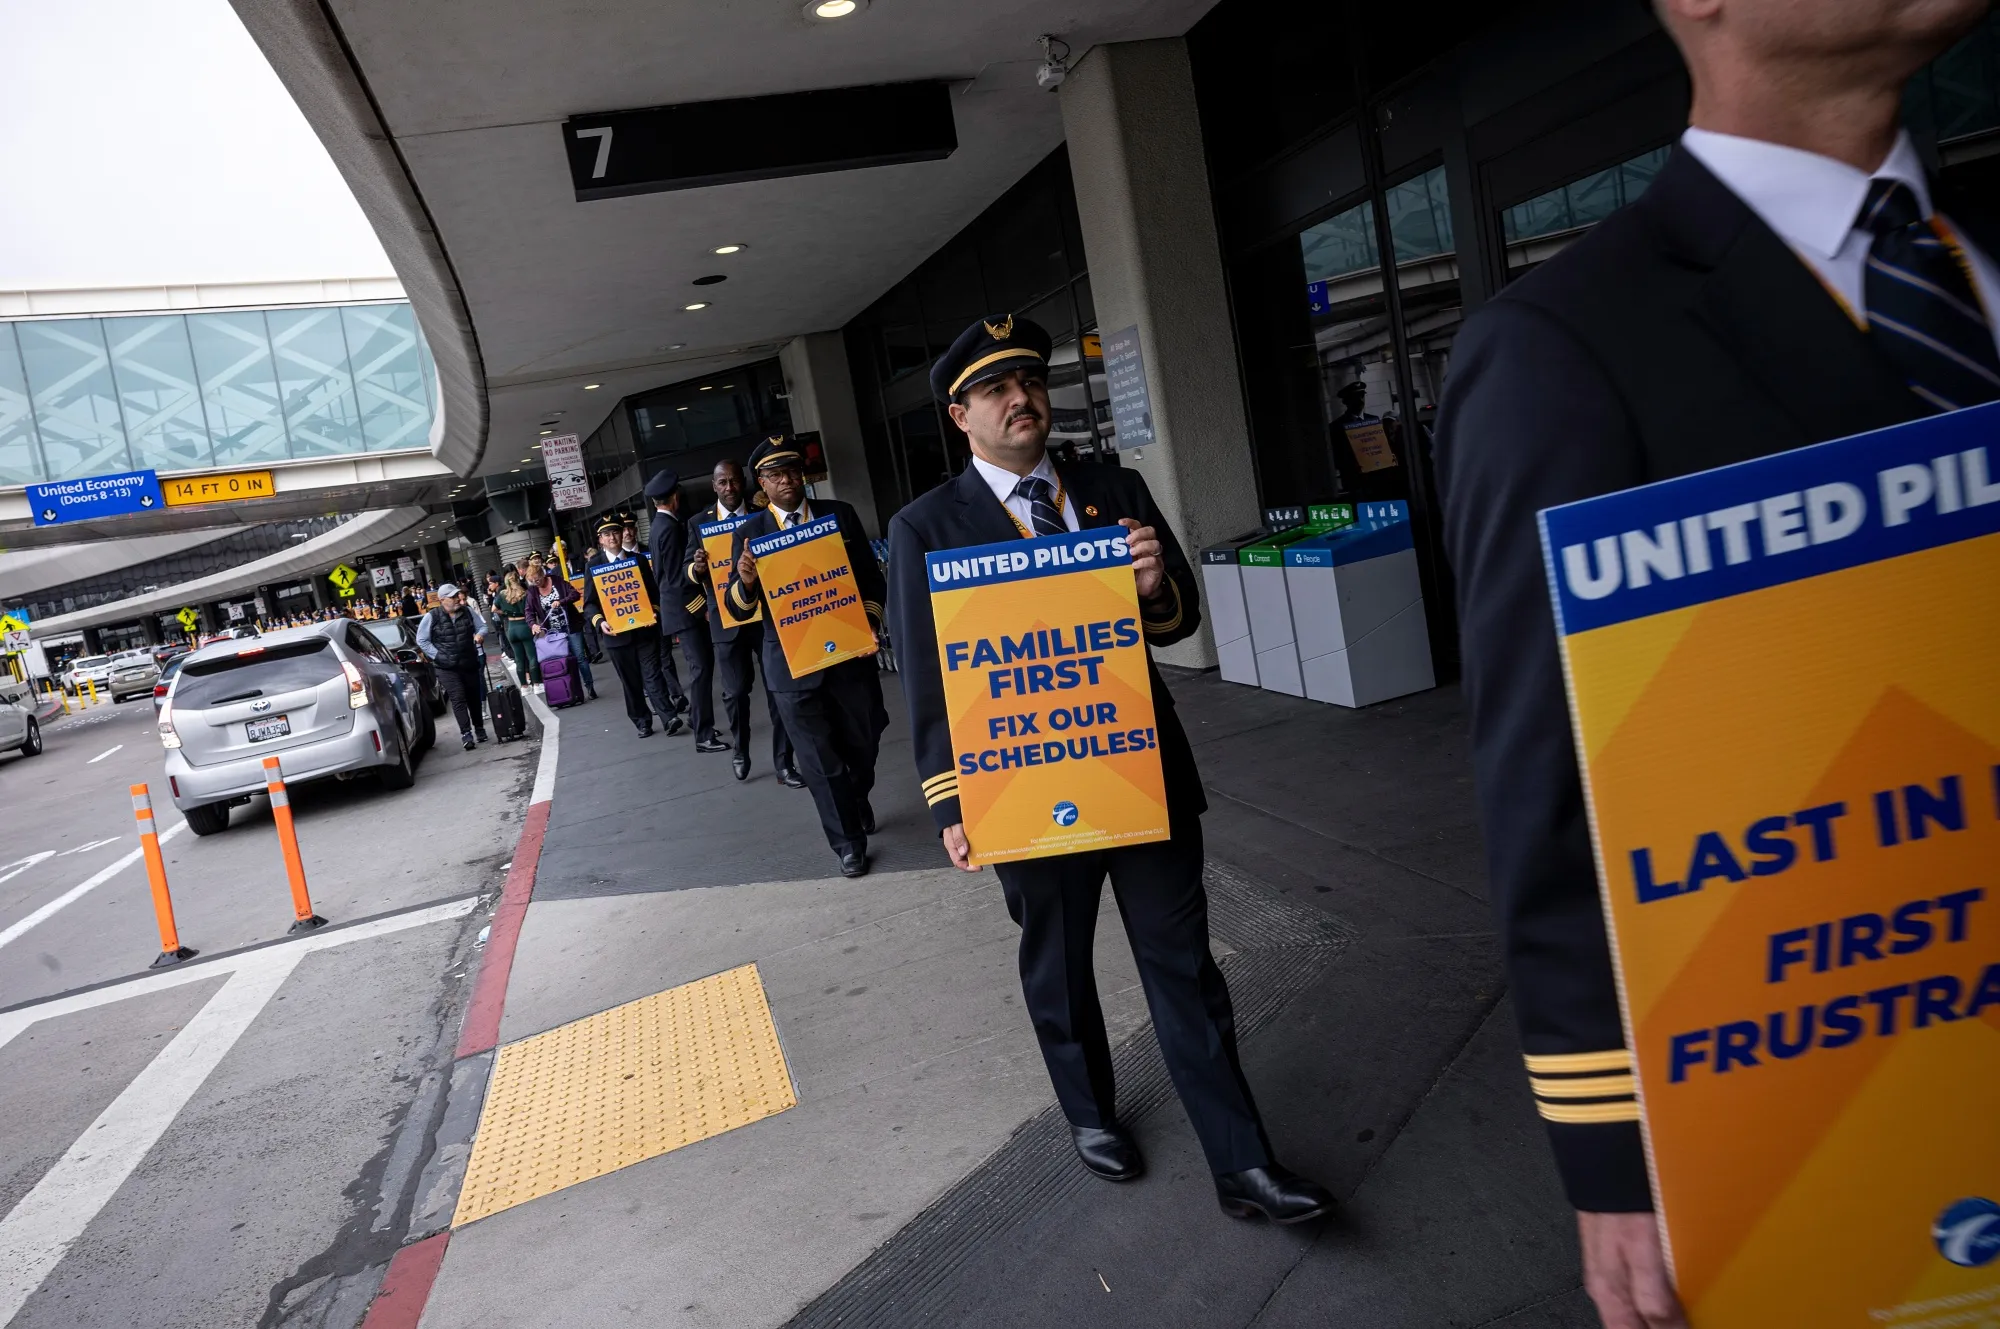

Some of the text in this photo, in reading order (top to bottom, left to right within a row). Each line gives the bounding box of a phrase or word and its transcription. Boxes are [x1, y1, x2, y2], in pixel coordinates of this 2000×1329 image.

[576, 126, 613, 179] 7
[1107, 357, 1120, 367] Subject
[544, 444, 579, 457] NO PARKING
[554, 436, 577, 447] WAITING
[38, 475, 145, 498] United Economy
[175, 478, 263, 498] 14 FT 0 IN
[553, 488, 571, 498] $100
[572, 485, 587, 494] FINE
[59, 487, 131, 507] (Doors 8 -13)
[701, 522, 735, 536] UNITED
[752, 520, 838, 555] UNITED PILOTS
[1562, 482, 1866, 601] UNITED
[357, 557, 364, 565] 9
[593, 560, 636, 575] UNITED PILOTS
[711, 558, 733, 569] LAS
[932, 536, 1128, 583] UNITED PILOTS
[1253, 555, 1271, 563] Compost
[1303, 555, 1320, 564] Recycle
[601, 570, 634, 586] FOUR
[768, 565, 849, 600] LAST IN LINE
[601, 580, 641, 597] YEARS
[609, 592, 639, 608] PAST
[791, 587, 838, 611] FIRST IN
[615, 603, 641, 617] DUE
[779, 594, 857, 628] FRUSTRATION
[945, 617, 1139, 672] FAMILIES
[988, 655, 1104, 699] FIRST
[249, 722, 288, 739] 8JWA350
[988, 702, 1118, 740] FIX OUR
[959, 727, 1157, 775] SCHEDULES!
[1629, 801, 1847, 904] LAST
[1872, 774, 1967, 848] IN
[1766, 887, 1987, 984] FIRST
